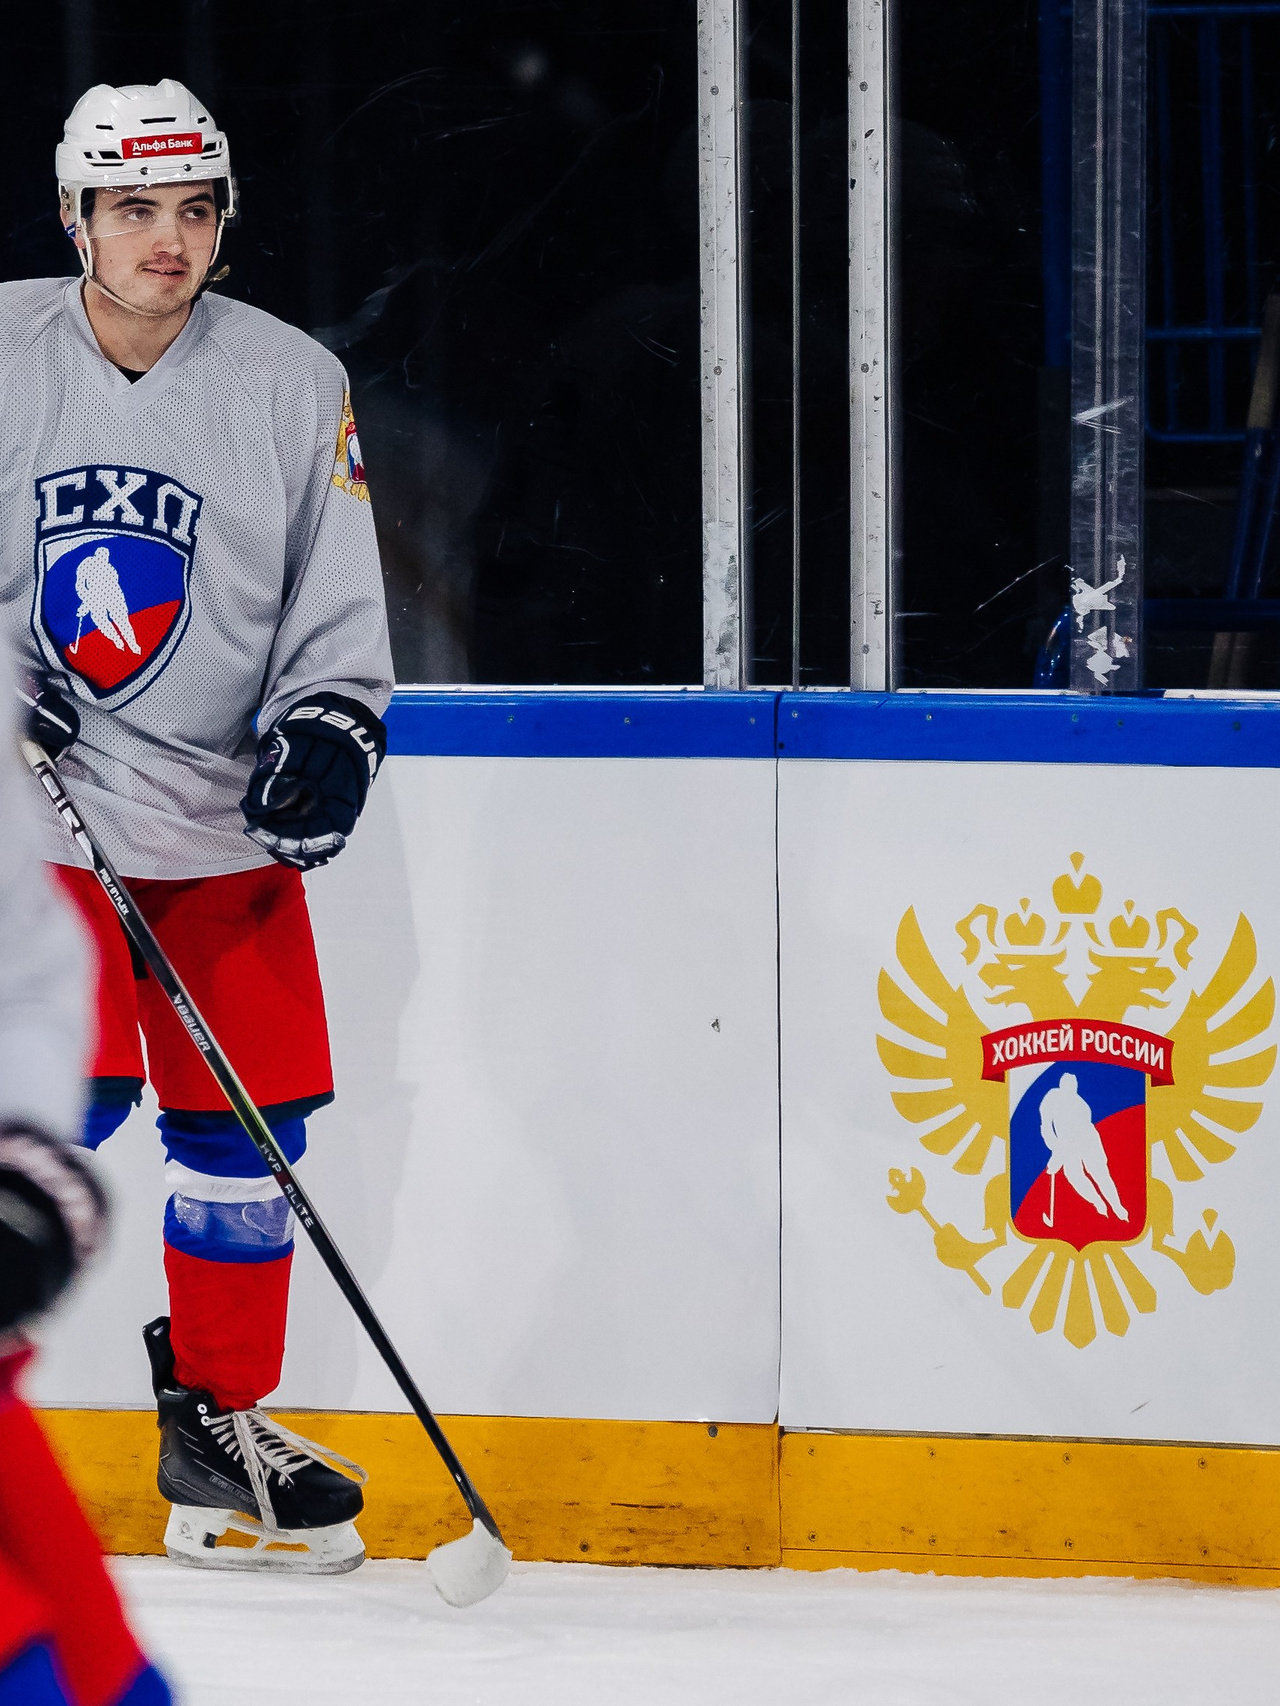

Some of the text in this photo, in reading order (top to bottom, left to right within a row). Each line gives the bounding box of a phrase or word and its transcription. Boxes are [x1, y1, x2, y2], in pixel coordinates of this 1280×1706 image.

[132, 138, 194, 156] Альфа Банк
[991, 1023, 1164, 1071] ХОККЕЙ РОССИИ
